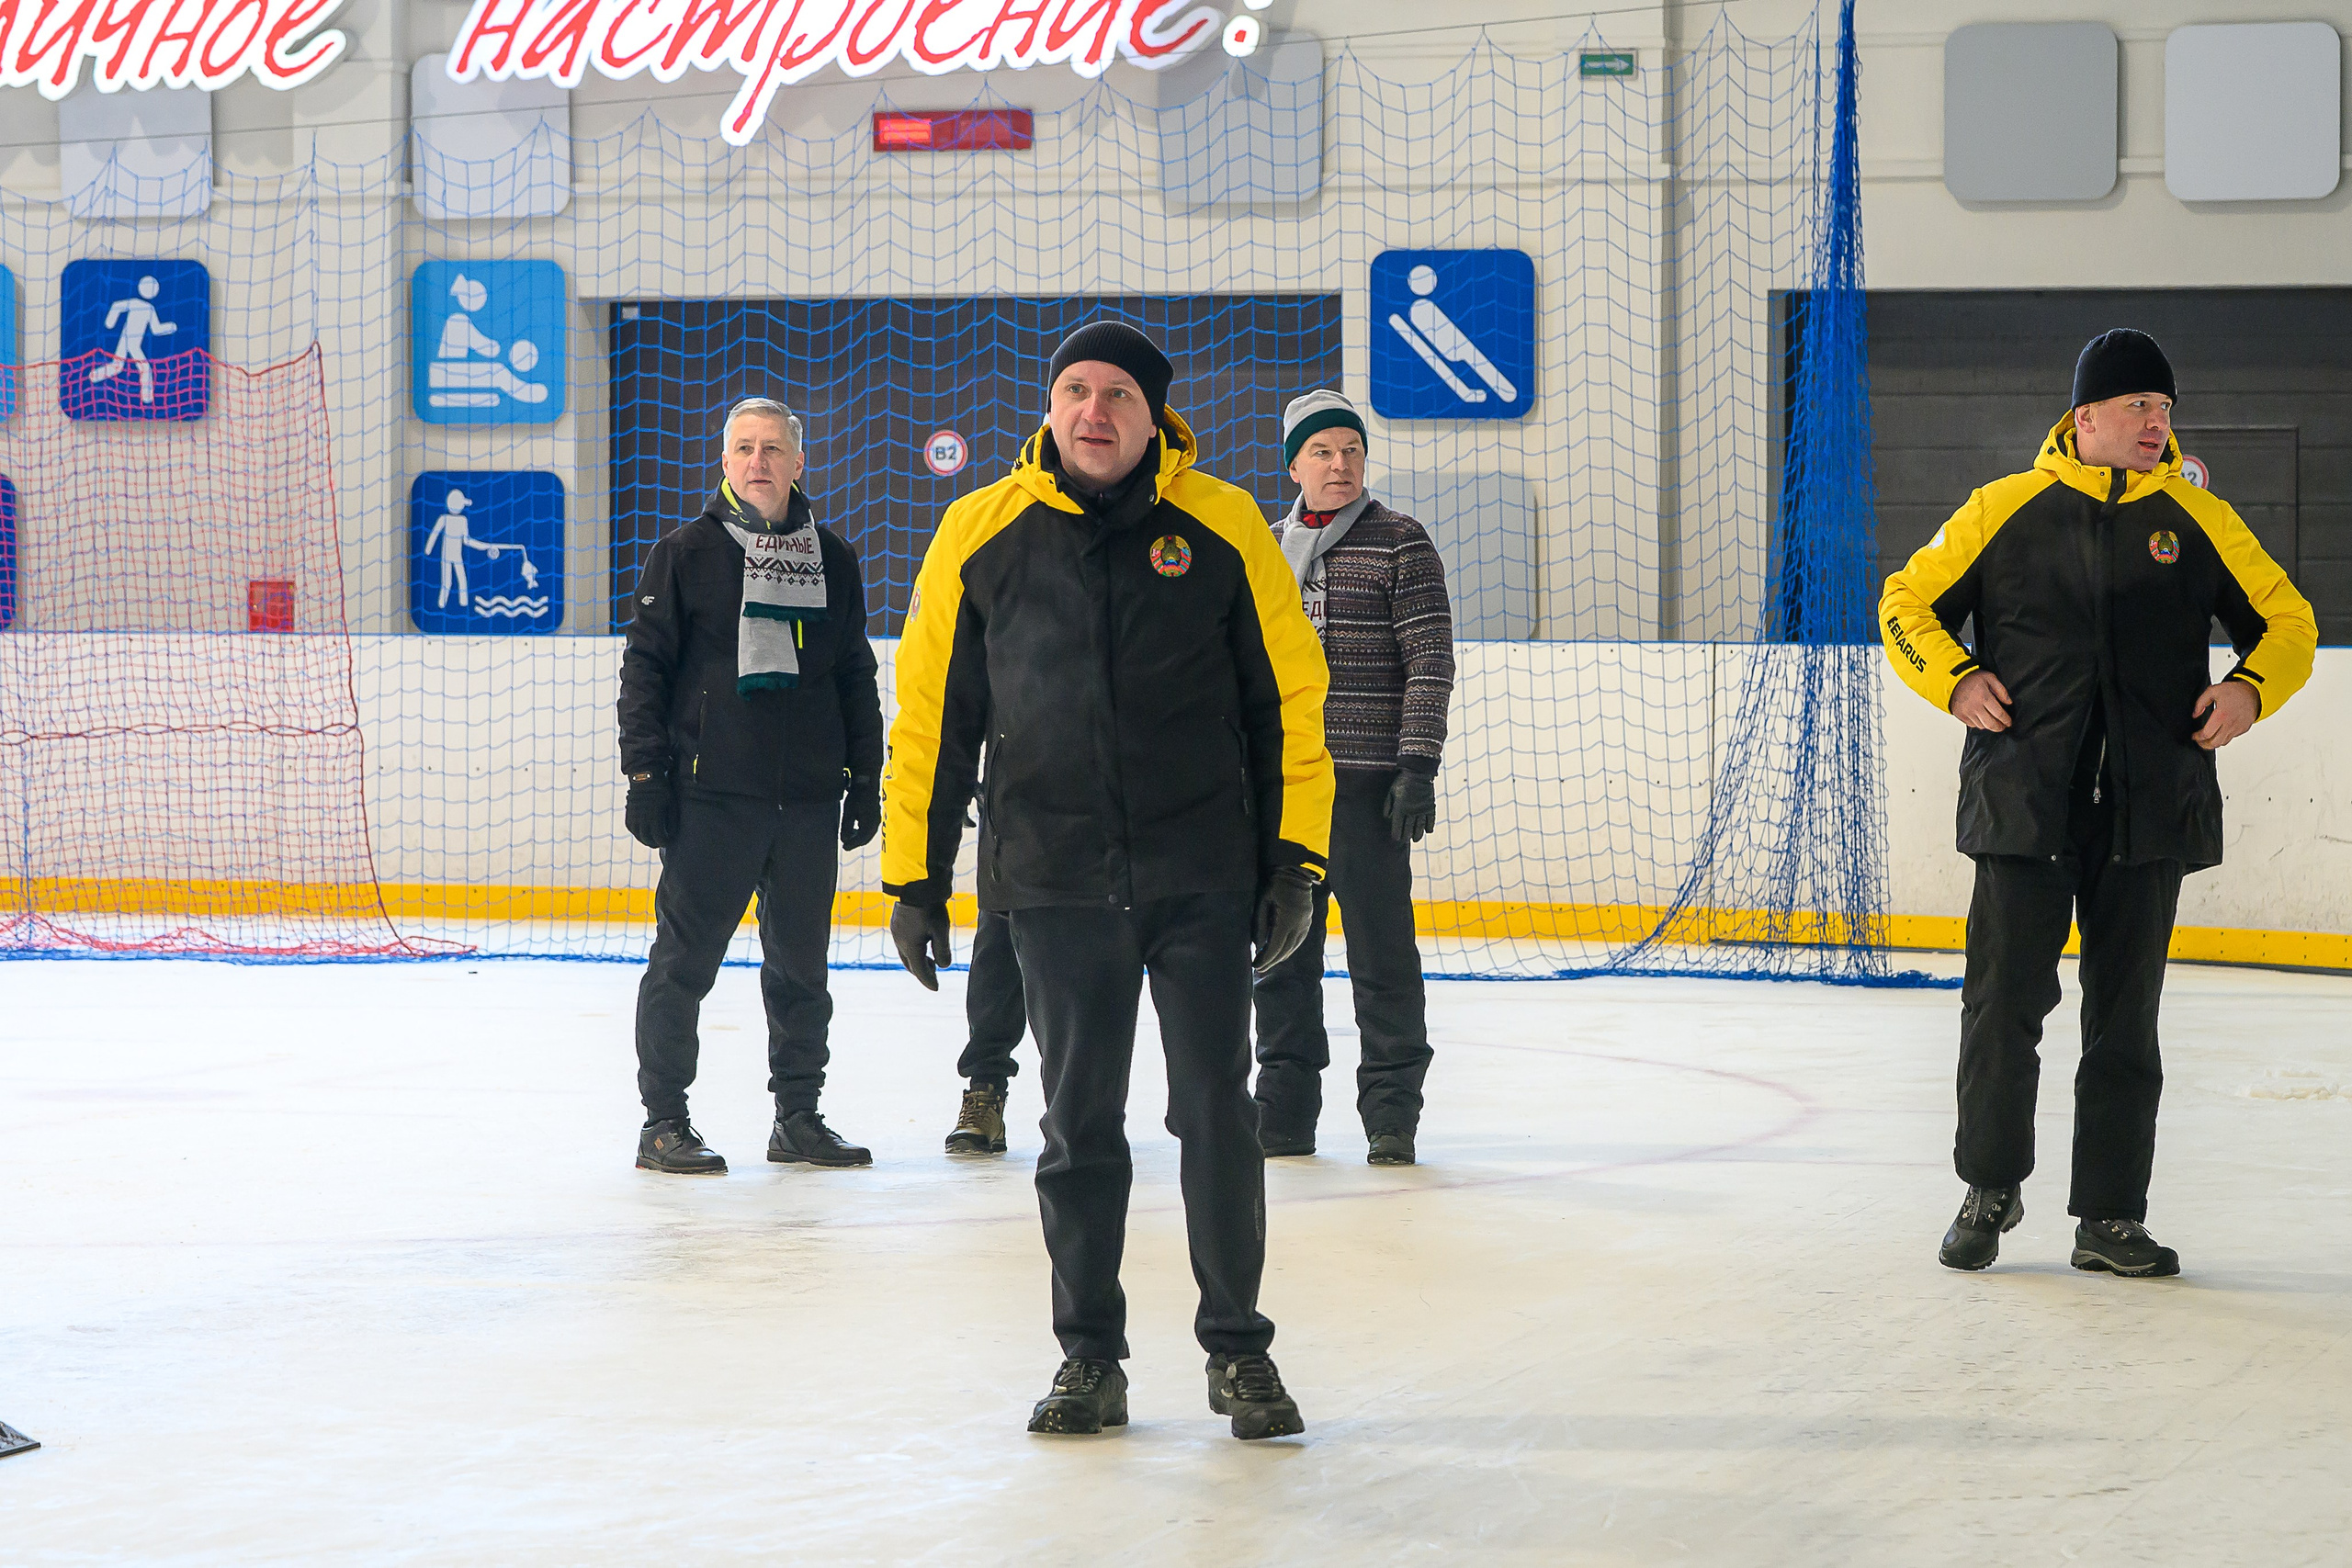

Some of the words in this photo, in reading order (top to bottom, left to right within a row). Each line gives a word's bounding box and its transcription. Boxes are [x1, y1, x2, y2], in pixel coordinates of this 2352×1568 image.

[456, 0, 1247, 132] настроение
[756, 535, 814, 554] ЕДИНЫЕ
[641, 595, 655, 605] 4F
